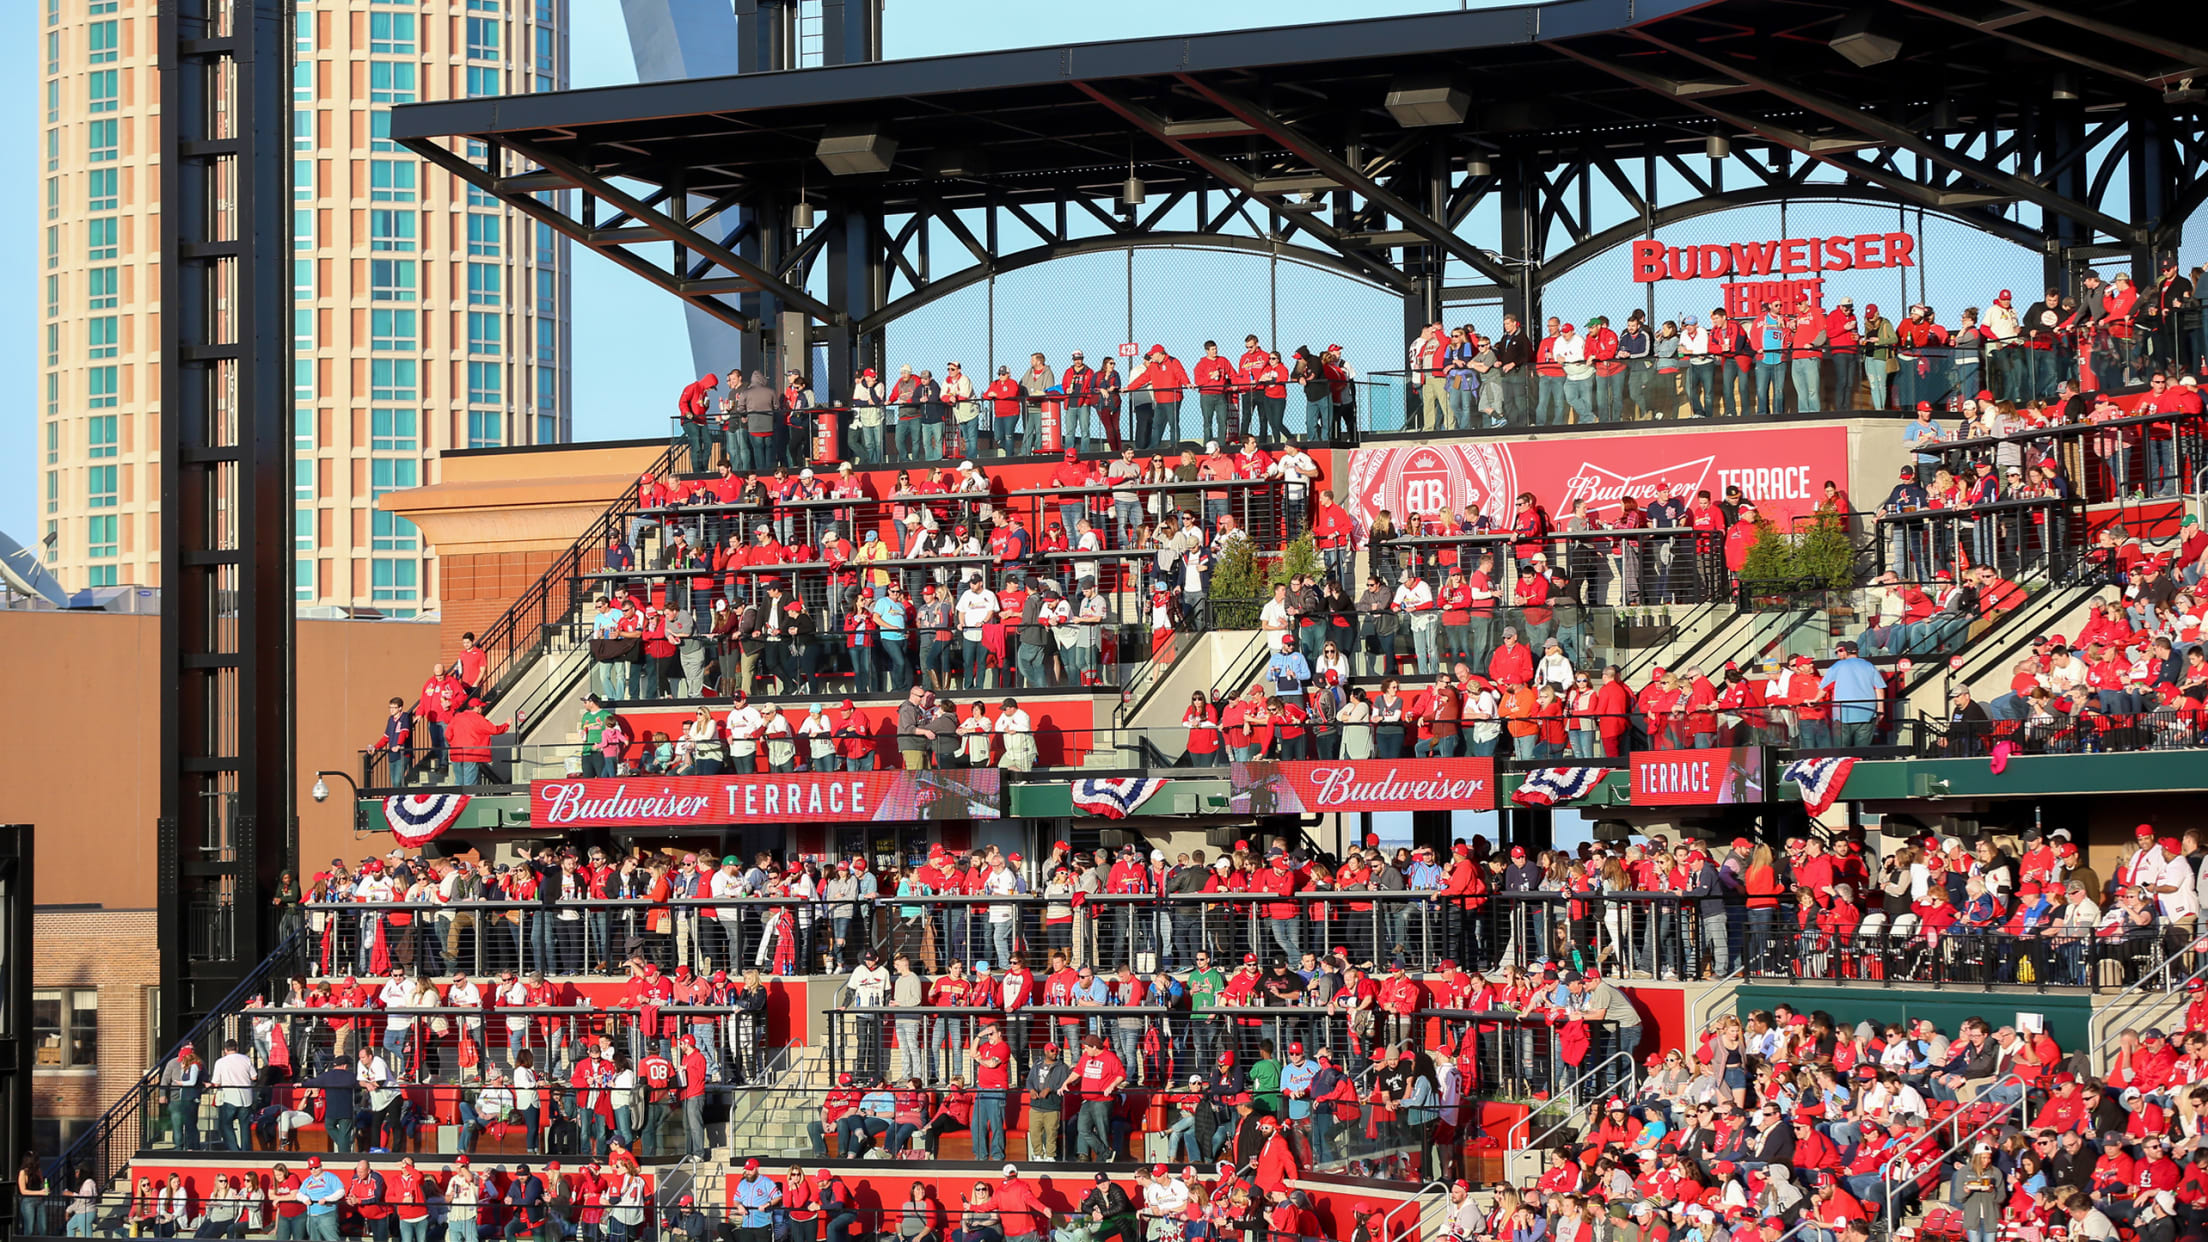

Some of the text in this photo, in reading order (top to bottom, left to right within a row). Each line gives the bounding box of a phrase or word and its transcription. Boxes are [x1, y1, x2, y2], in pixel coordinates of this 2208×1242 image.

[1632, 232, 1915, 283] BUDWEISER
[1121, 344, 1136, 355] 428
[1462, 444, 1482, 471] UROPE
[1406, 479, 1447, 516] AB
[1567, 465, 1811, 503] Budweer TERRACE
[1310, 767, 1484, 805] Budweiser
[1640, 761, 1711, 794] TERRACE
[541, 782, 865, 823] Budweiser TERRACE
[650, 1065, 668, 1080] 08
